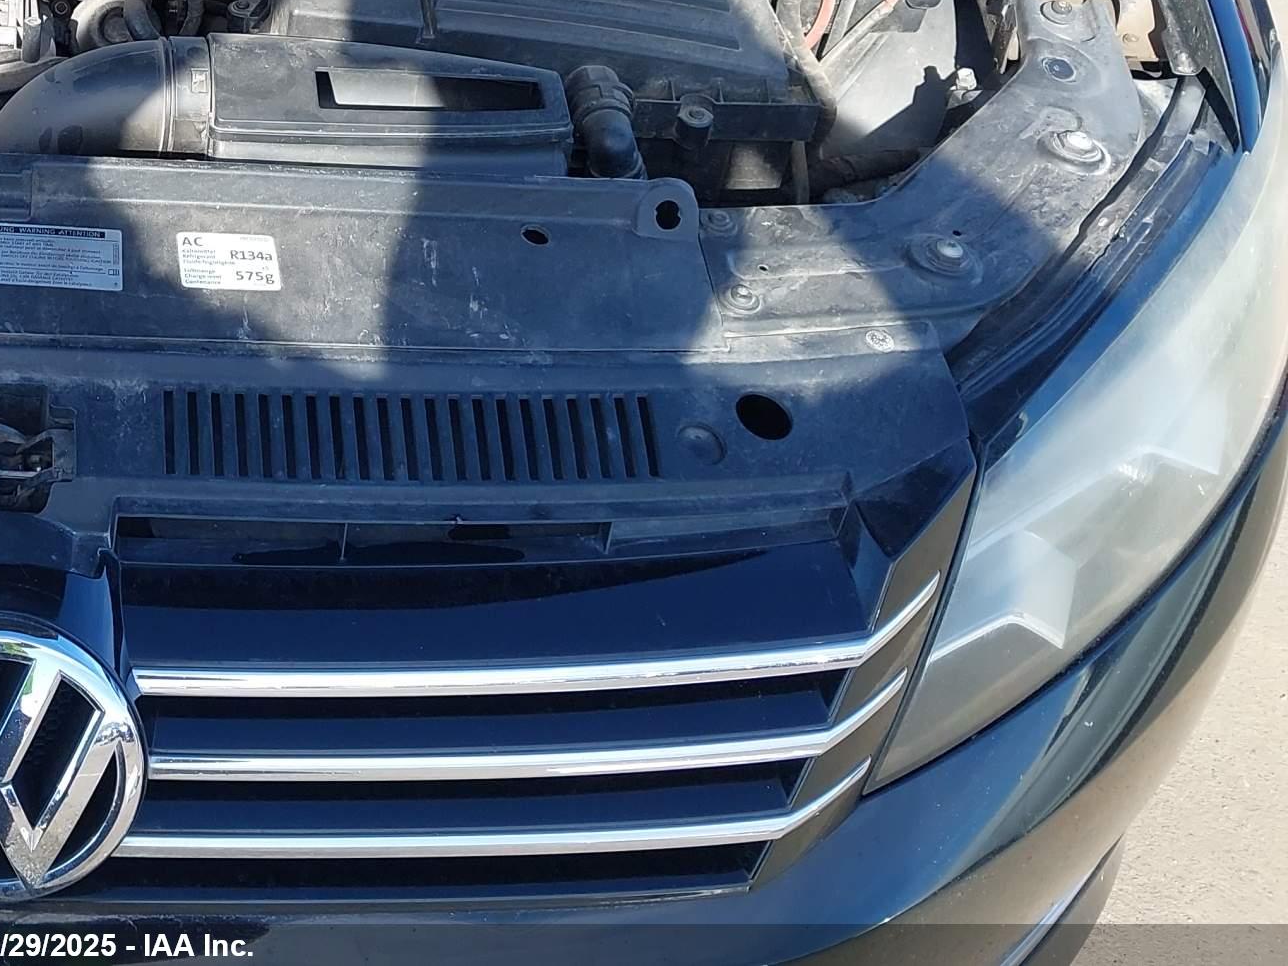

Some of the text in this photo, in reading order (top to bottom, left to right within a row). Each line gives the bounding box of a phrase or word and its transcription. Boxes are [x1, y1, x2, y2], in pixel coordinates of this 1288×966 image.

[19, 227, 56, 235] WARNING
[59, 229, 101, 238] ATTENTION
[229, 249, 273, 261] R134a
[235, 270, 275, 285] 575g
